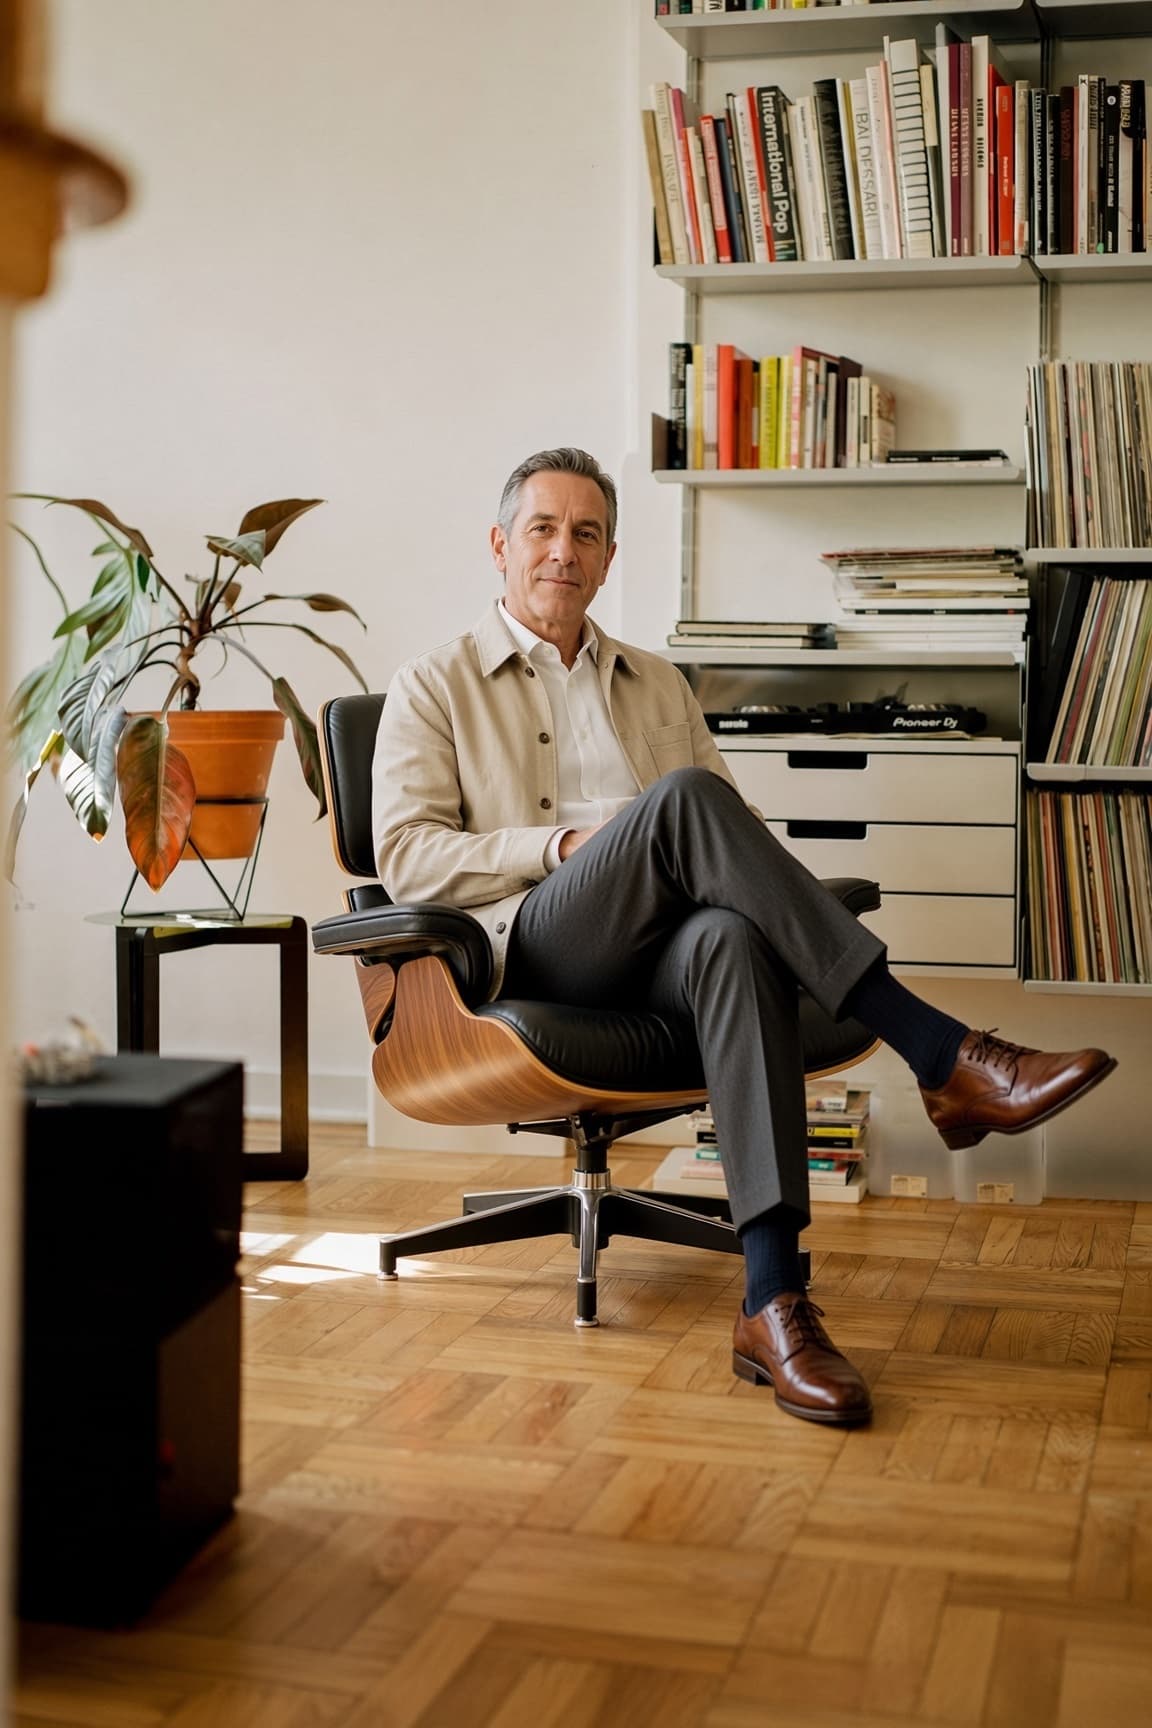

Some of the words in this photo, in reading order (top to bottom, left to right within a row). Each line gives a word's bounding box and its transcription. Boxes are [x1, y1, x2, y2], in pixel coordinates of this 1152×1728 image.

[761, 91, 787, 197] International
[774, 199, 789, 234] Pop
[893, 716, 942, 728] Pioneer
